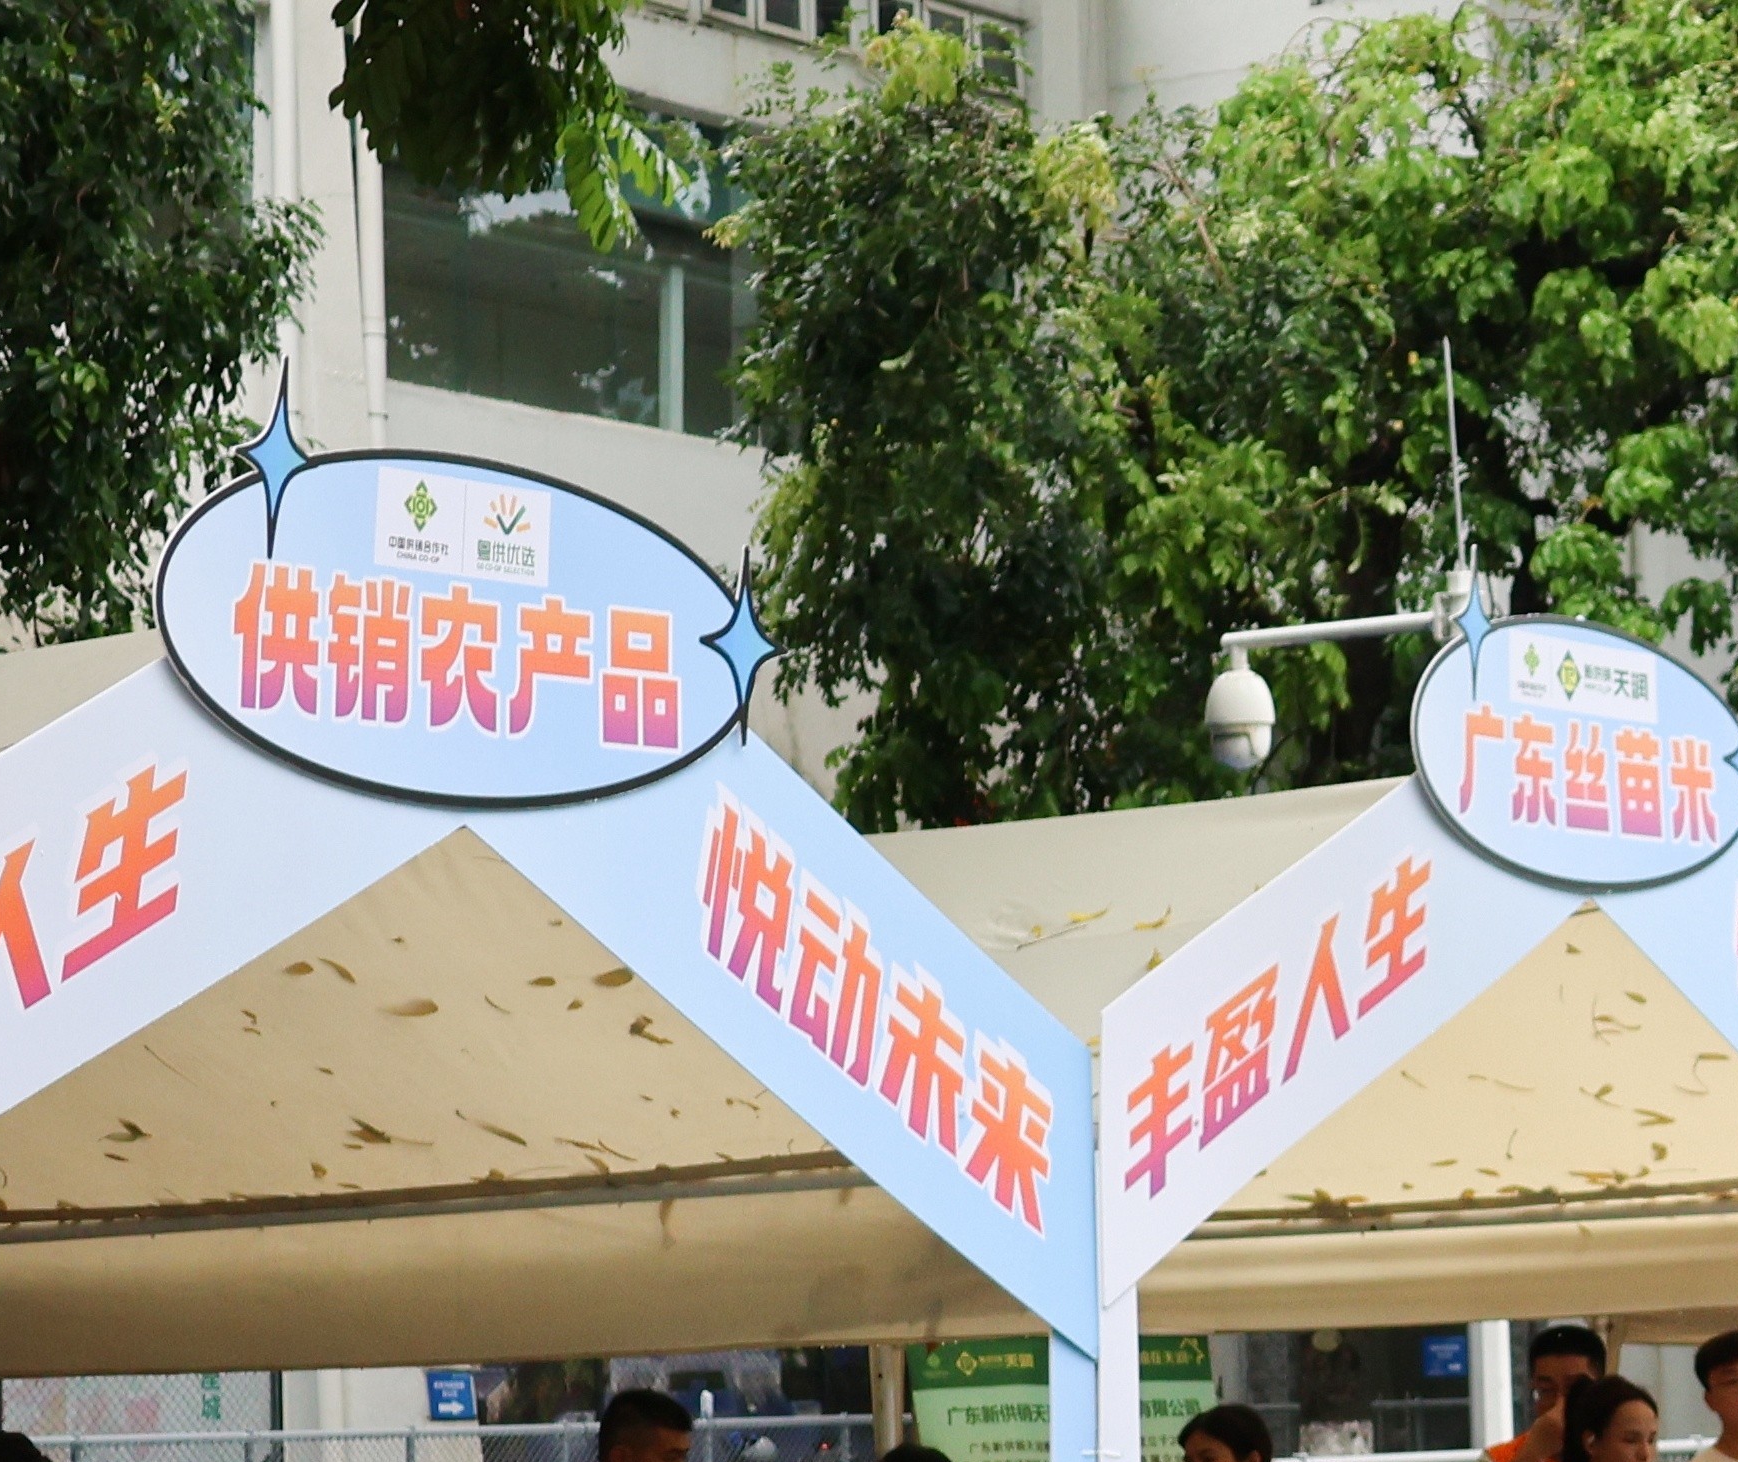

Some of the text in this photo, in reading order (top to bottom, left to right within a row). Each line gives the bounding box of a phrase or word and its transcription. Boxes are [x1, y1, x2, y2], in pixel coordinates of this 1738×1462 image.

[234, 564, 679, 749] 供销农产品
[1459, 706, 1717, 842] 广东丝苗米
[701, 803, 1050, 1235] 悦动未来
[1125, 855, 1432, 1199] 丰盈人生
[948, 1403, 1049, 1426] 广东新供销天
